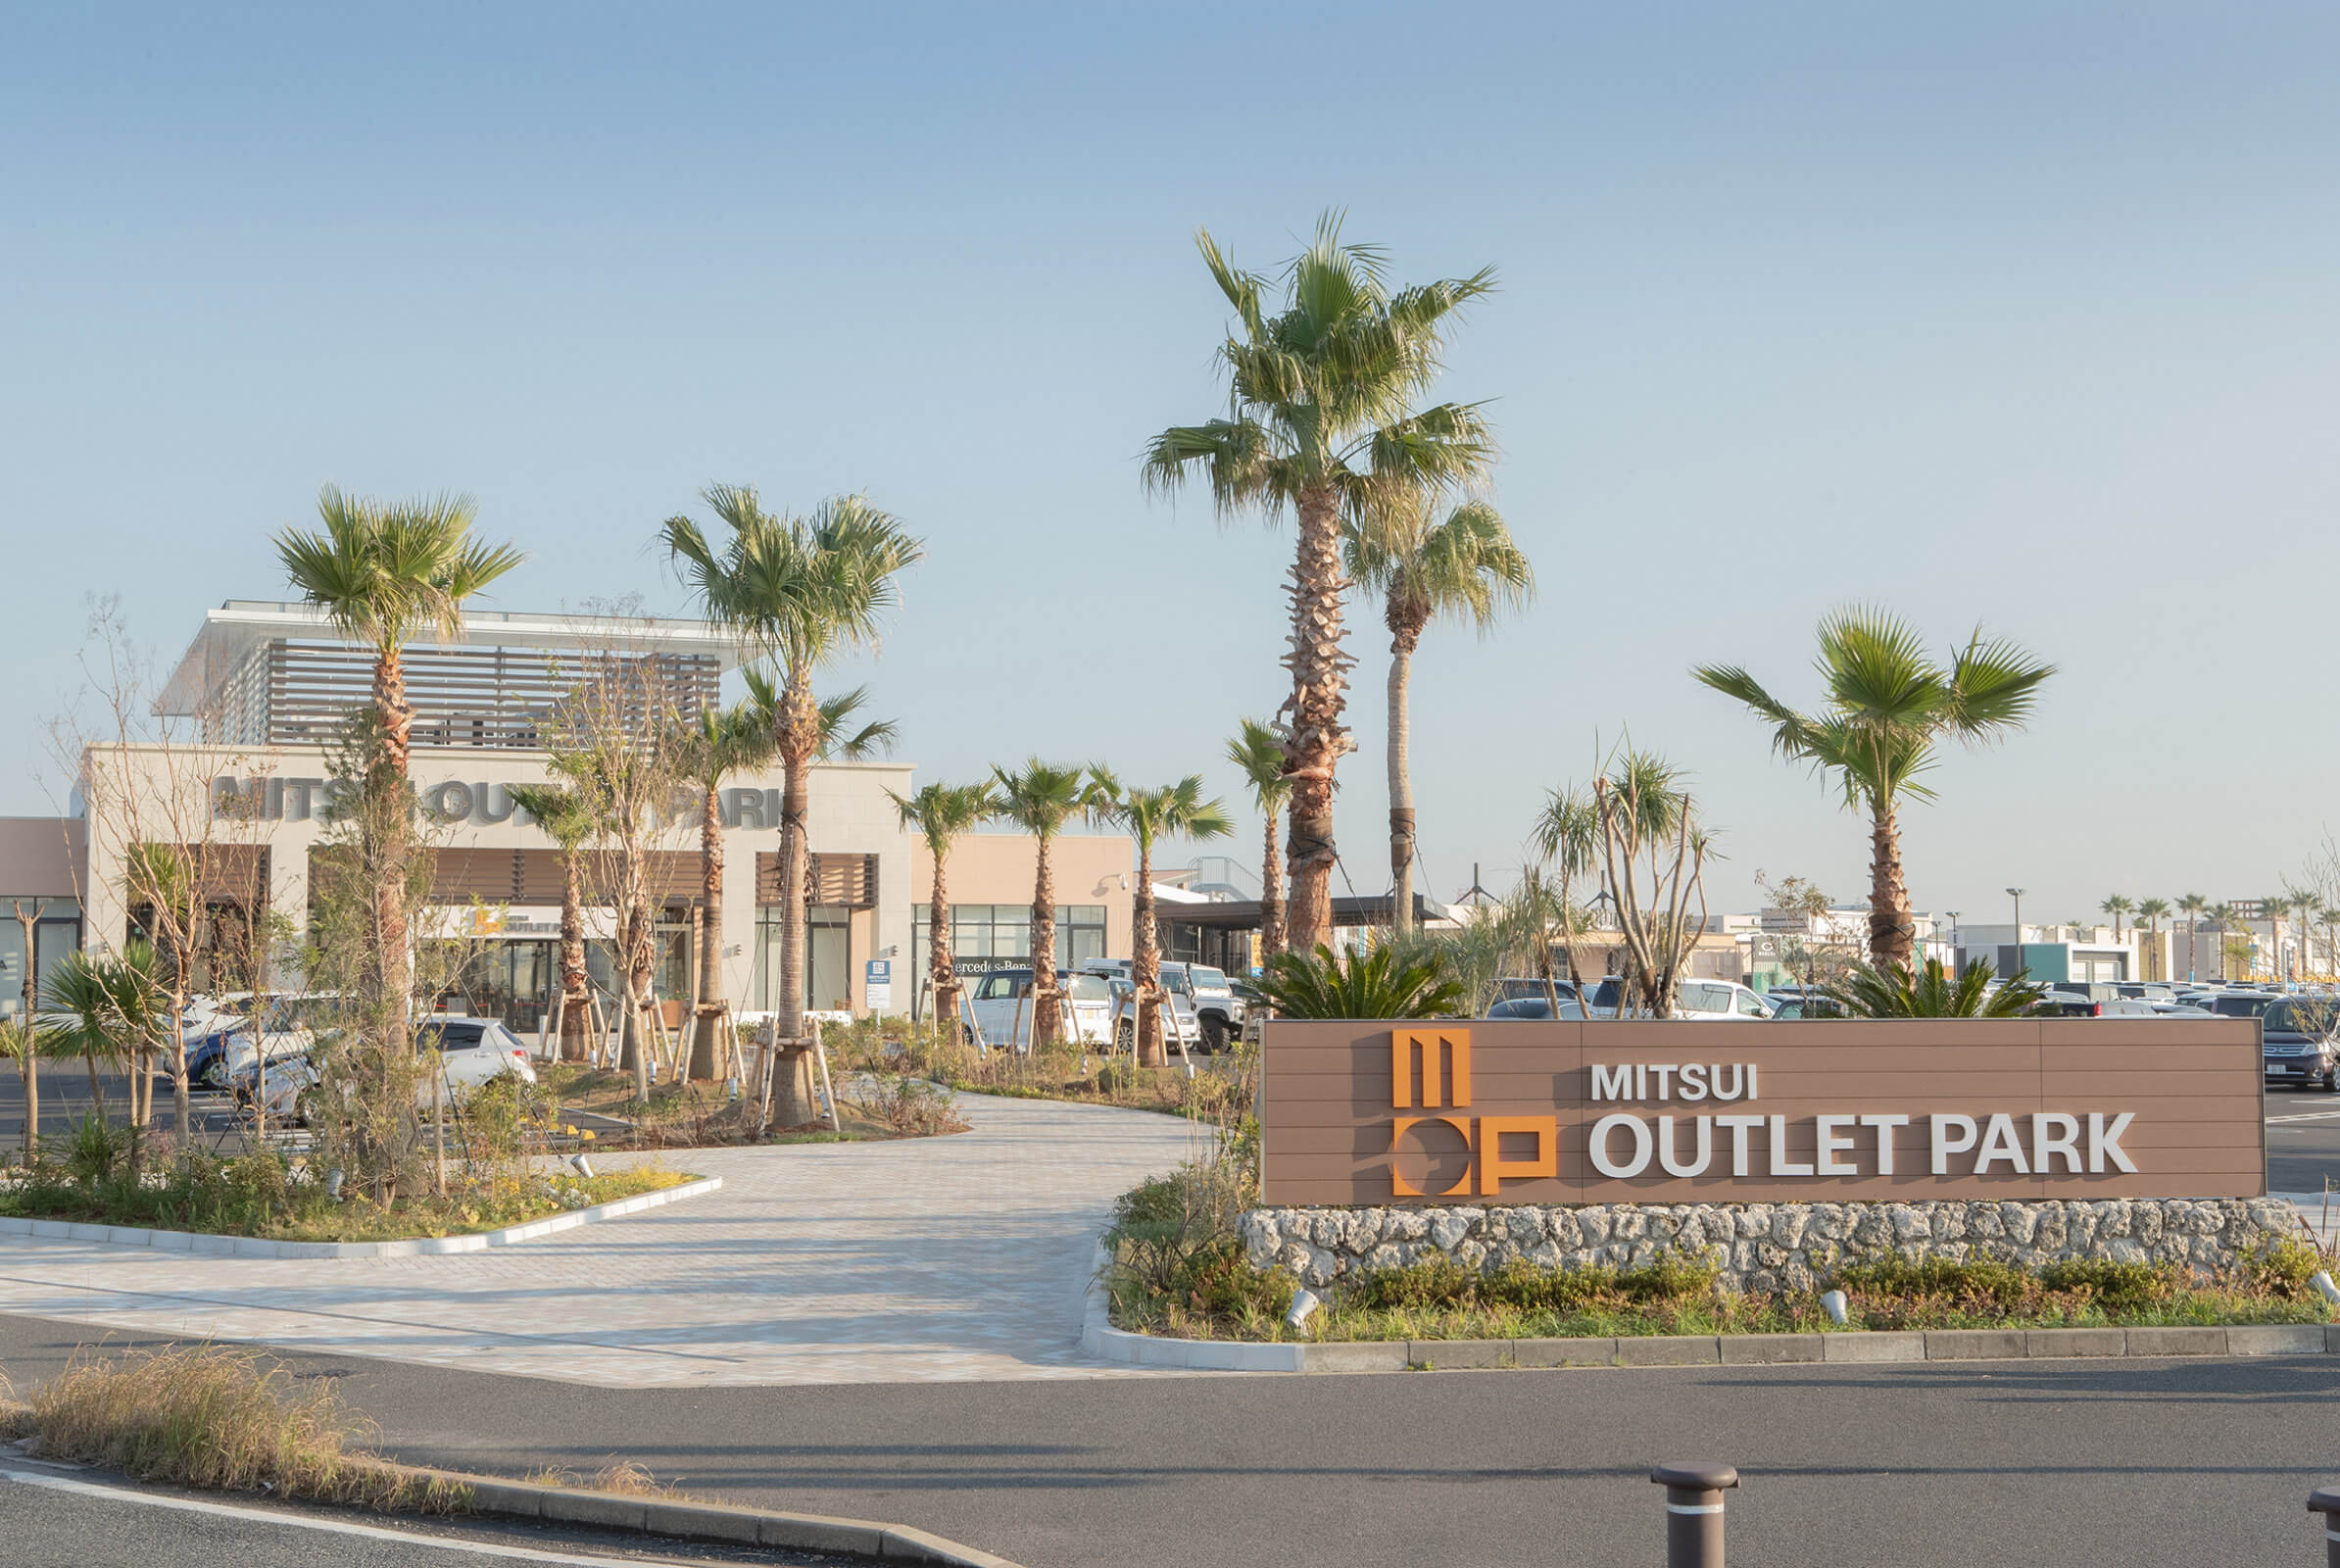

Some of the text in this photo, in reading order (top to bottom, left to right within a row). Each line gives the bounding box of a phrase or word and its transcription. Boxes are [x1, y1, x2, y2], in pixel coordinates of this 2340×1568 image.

[1590, 1063, 1759, 1101] MITSUI
[1588, 1112, 2139, 1179] OUTLET PARK
